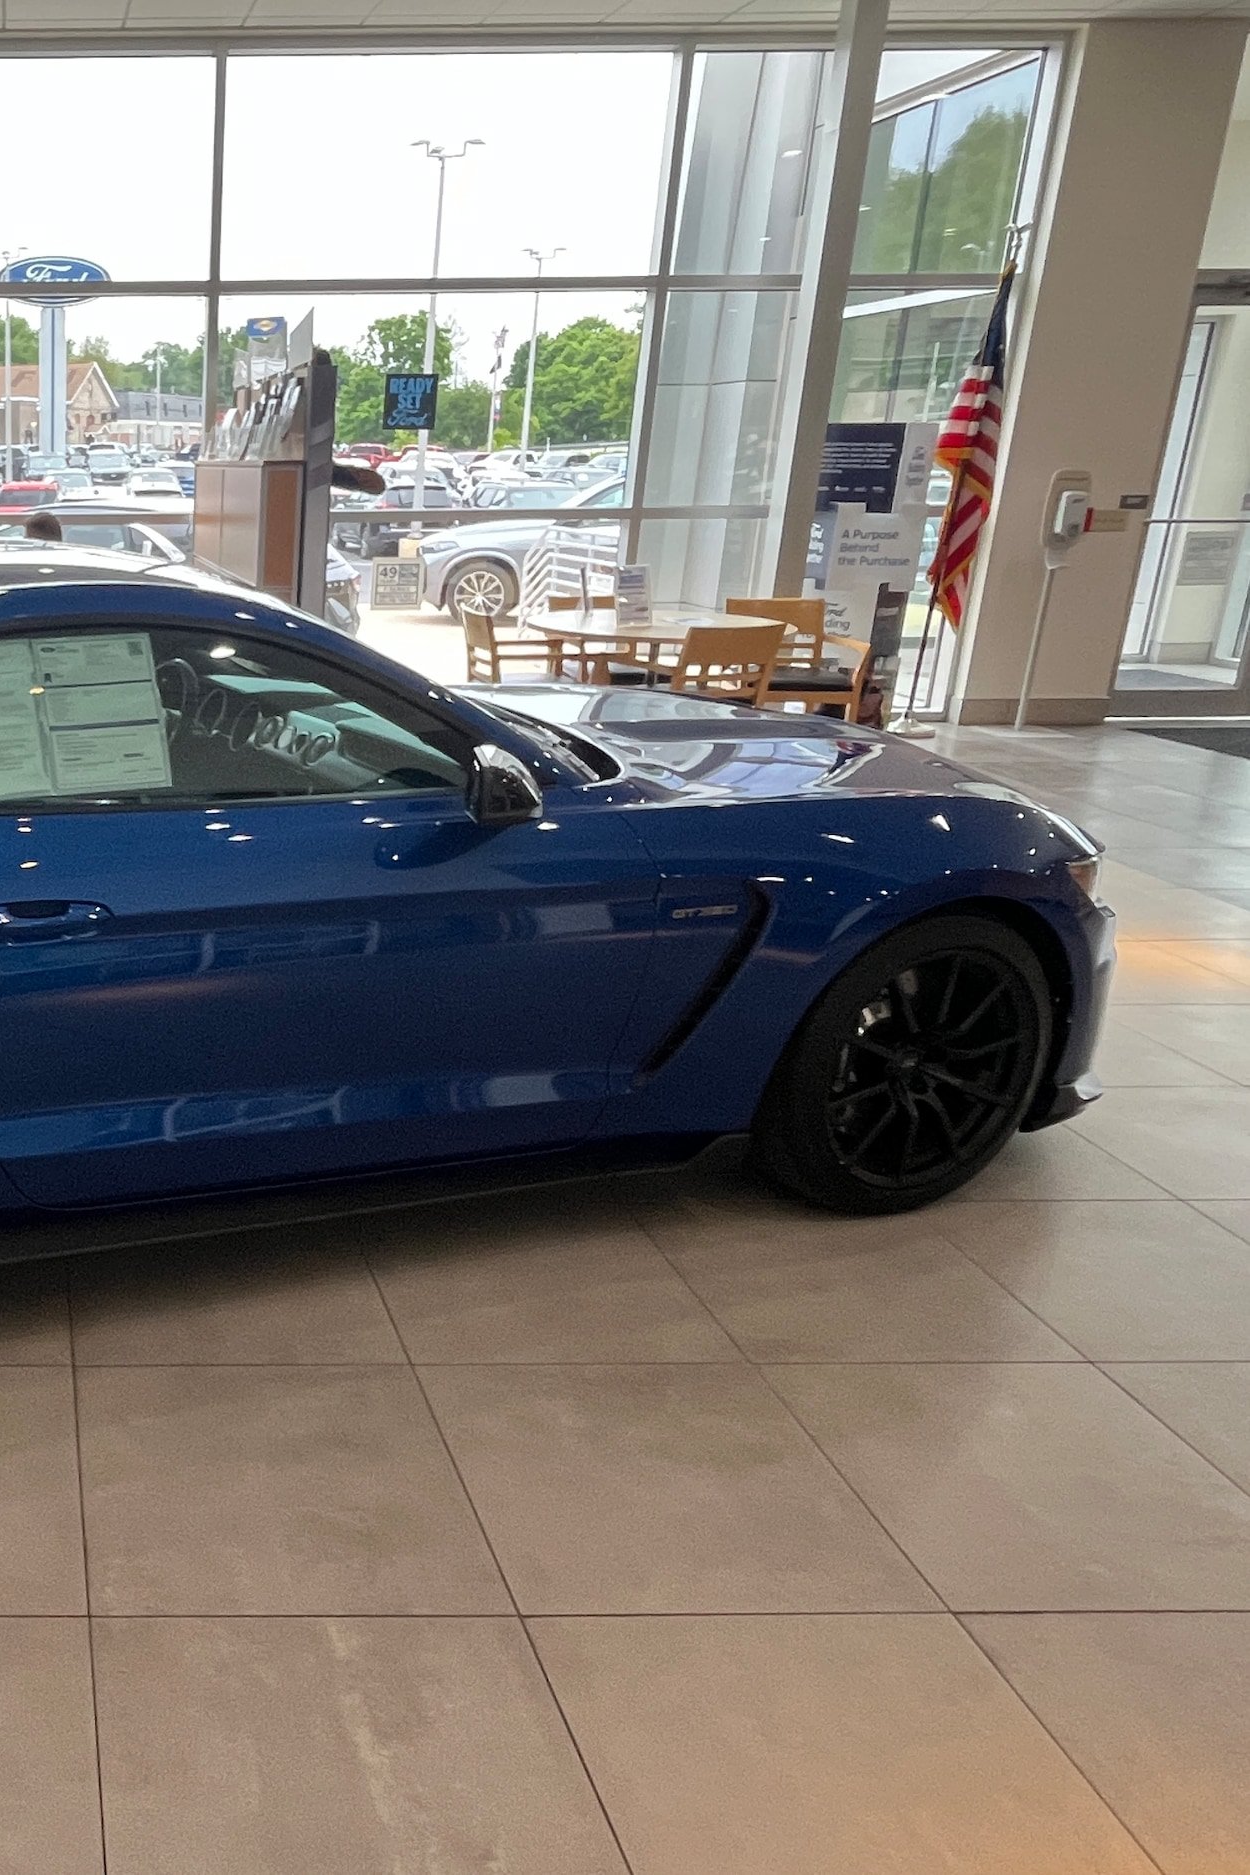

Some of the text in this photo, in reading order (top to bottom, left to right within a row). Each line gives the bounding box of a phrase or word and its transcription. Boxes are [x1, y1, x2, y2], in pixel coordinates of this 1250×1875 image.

[390, 378, 434, 393] READY
[398, 393, 421, 409] SET
[387, 409, 427, 426] Ford
[842, 530, 899, 541] A Purpose
[840, 543, 879, 553] Behind
[838, 556, 910, 567] the Purchase
[379, 567, 397, 579] 49
